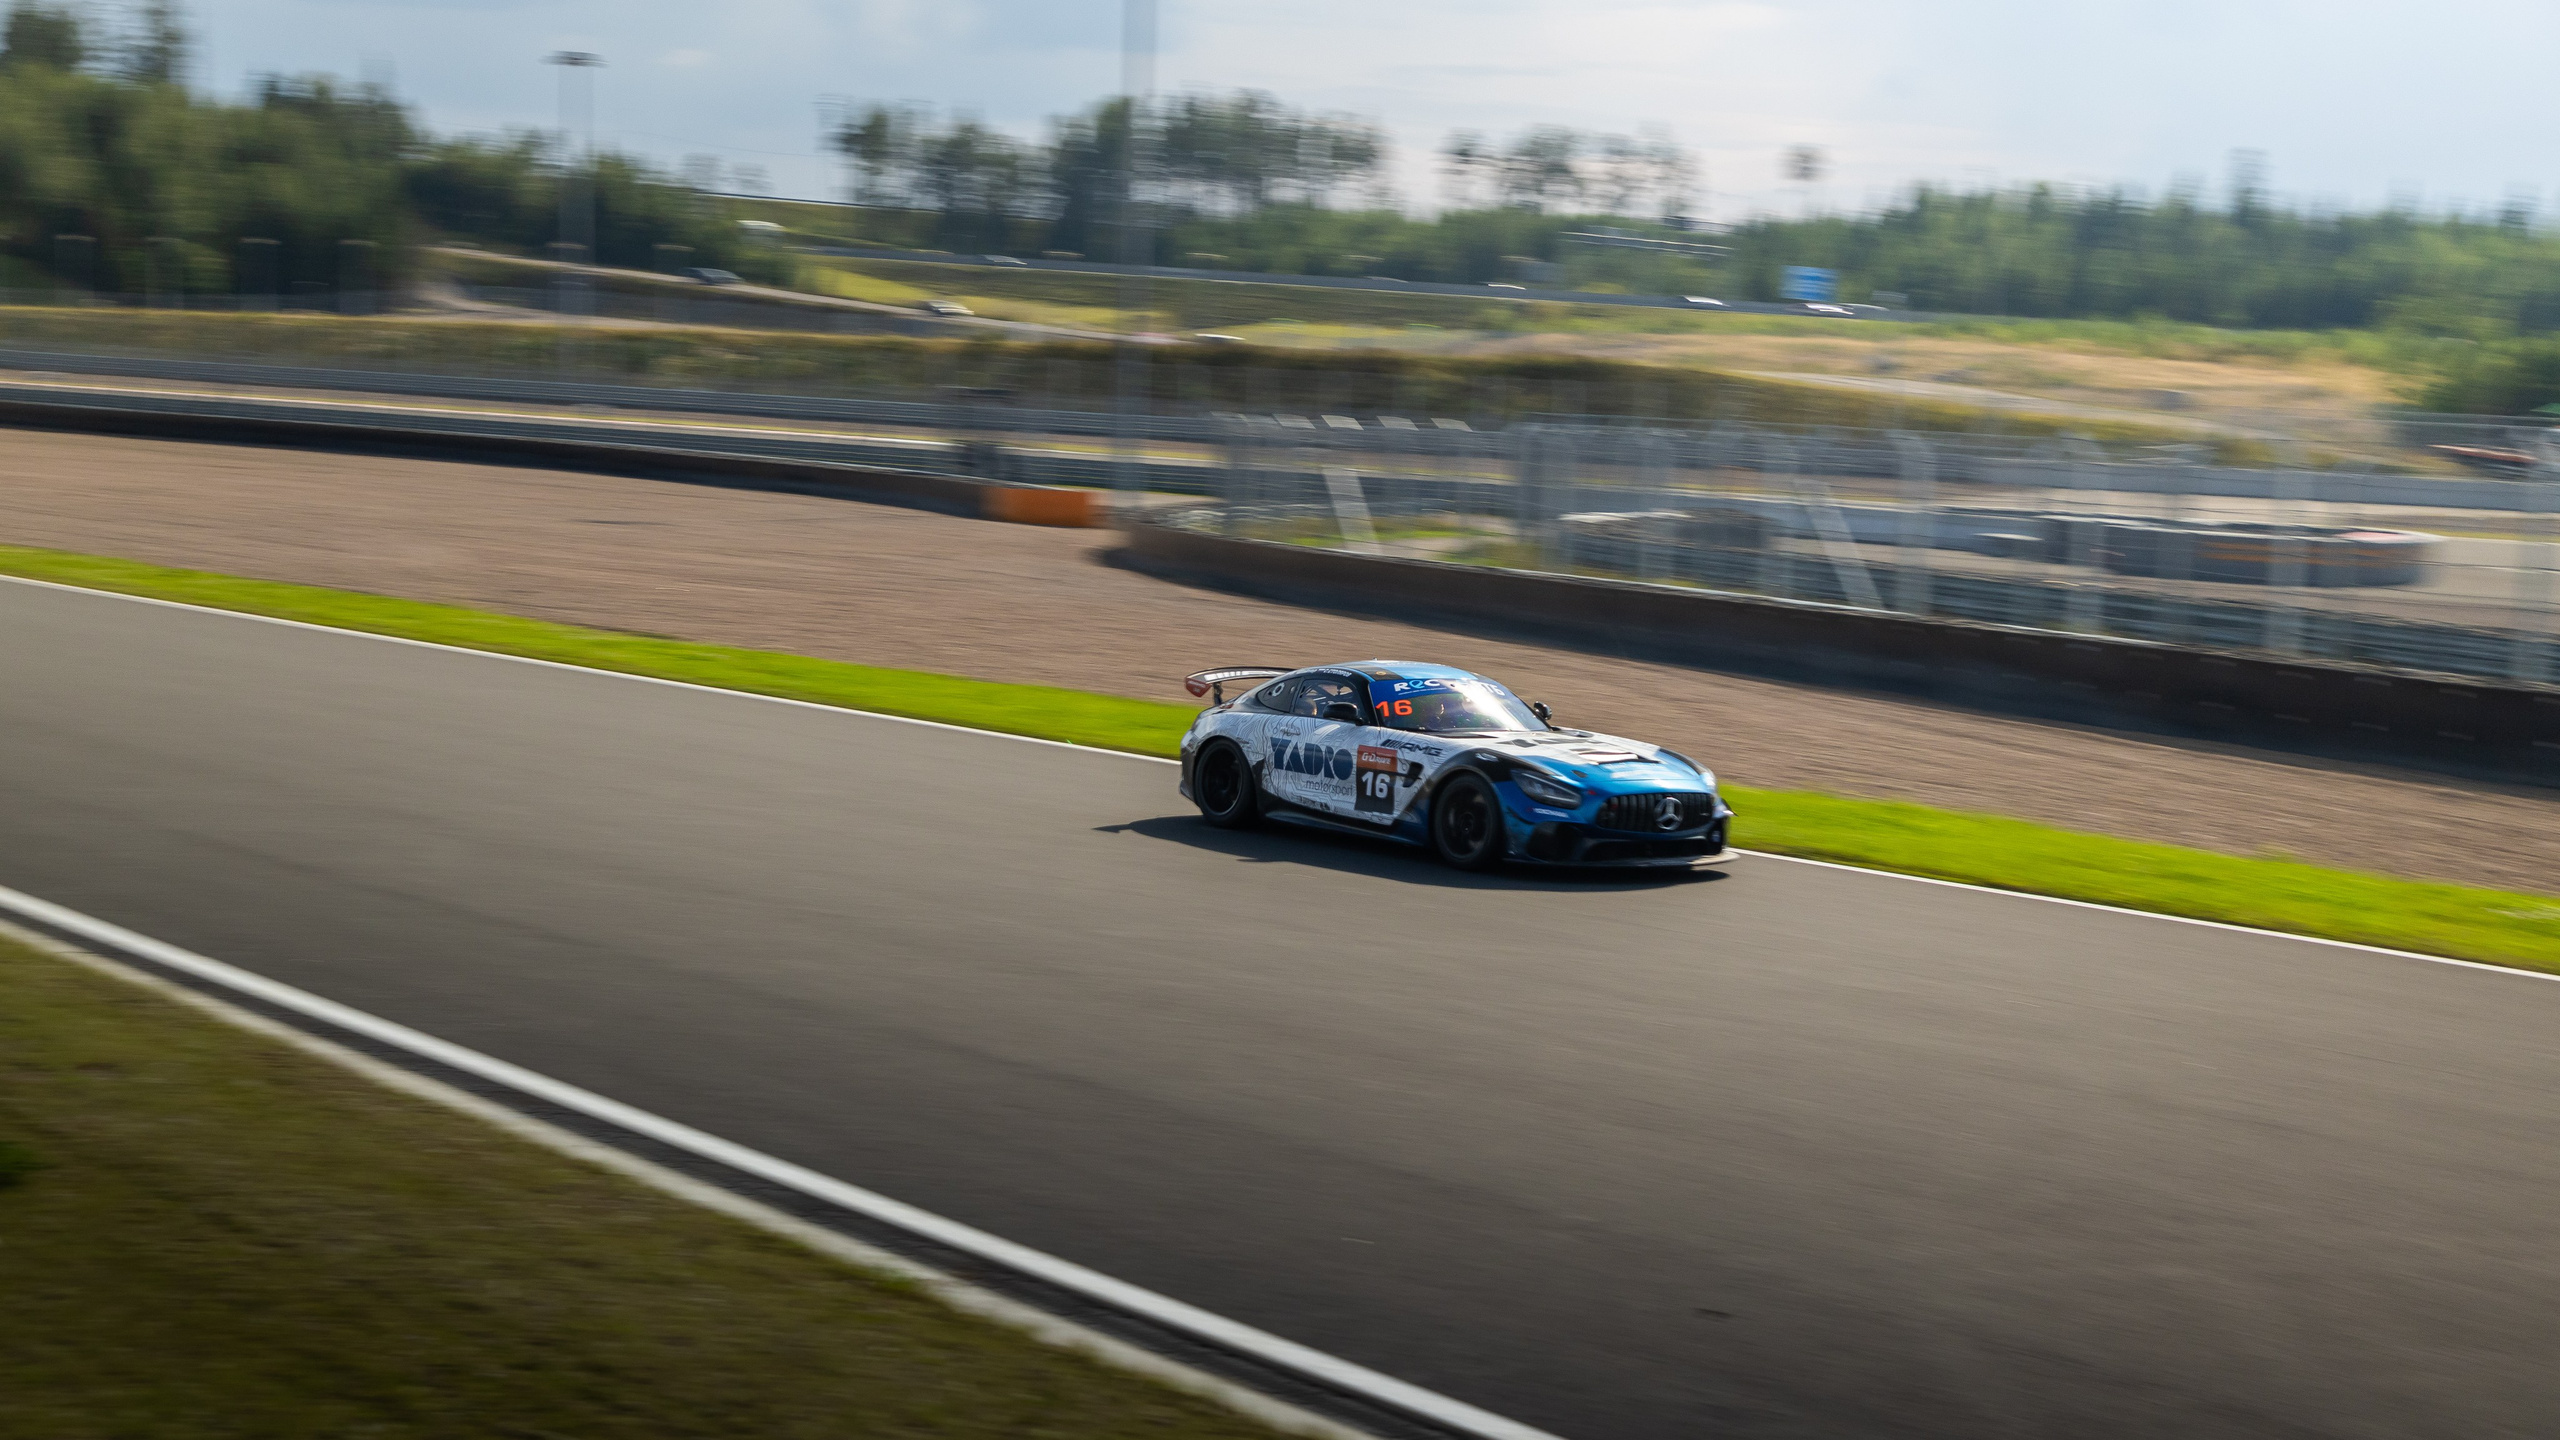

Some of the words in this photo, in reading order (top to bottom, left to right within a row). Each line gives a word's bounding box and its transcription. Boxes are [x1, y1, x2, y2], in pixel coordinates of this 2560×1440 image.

[1376, 699, 1413, 717] 16
[1270, 737, 1354, 780] YADRO
[1397, 742, 1443, 757] AMG
[1305, 779, 1355, 797] motorsport
[1361, 770, 1391, 798] 16
